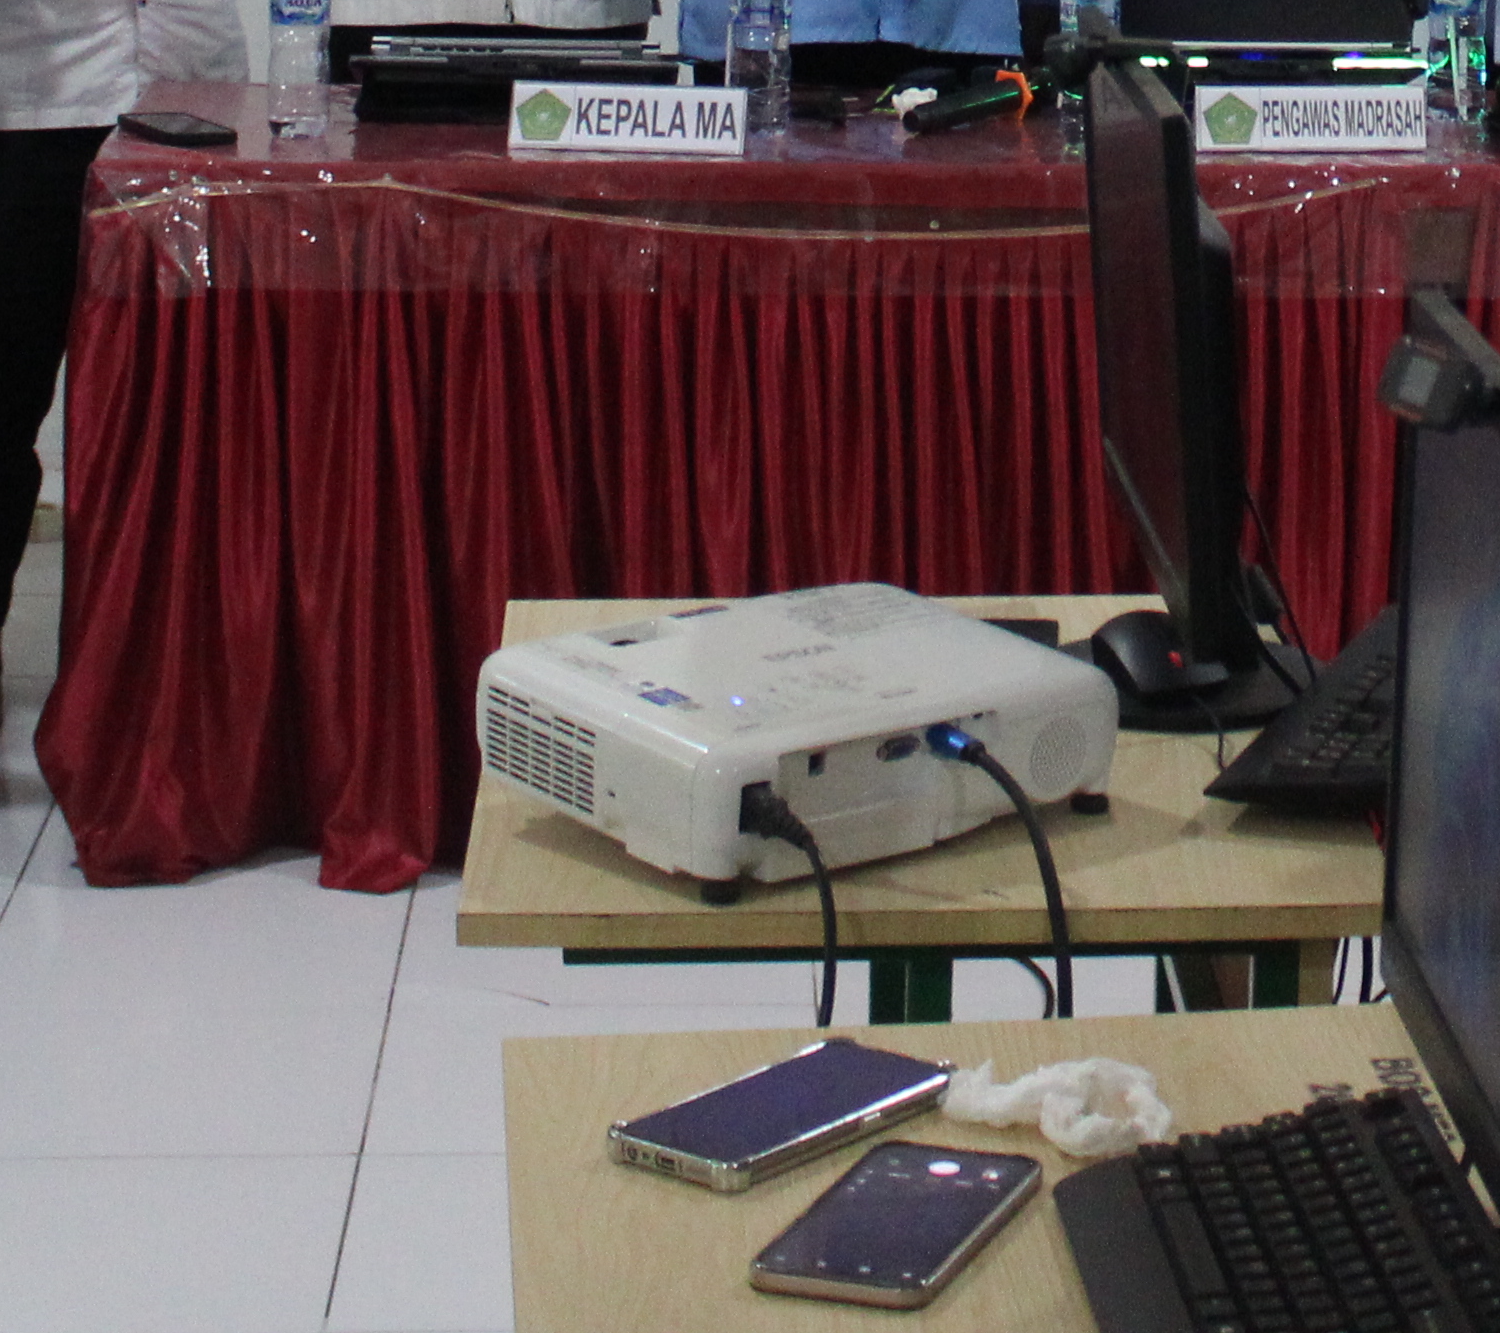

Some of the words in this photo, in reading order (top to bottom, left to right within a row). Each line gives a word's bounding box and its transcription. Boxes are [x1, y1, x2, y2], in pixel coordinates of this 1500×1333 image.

[574, 97, 687, 139] KEPALA
[695, 100, 738, 140] MA
[1261, 99, 1342, 138] PENGAWAS
[1344, 99, 1424, 138] MADRASAH
